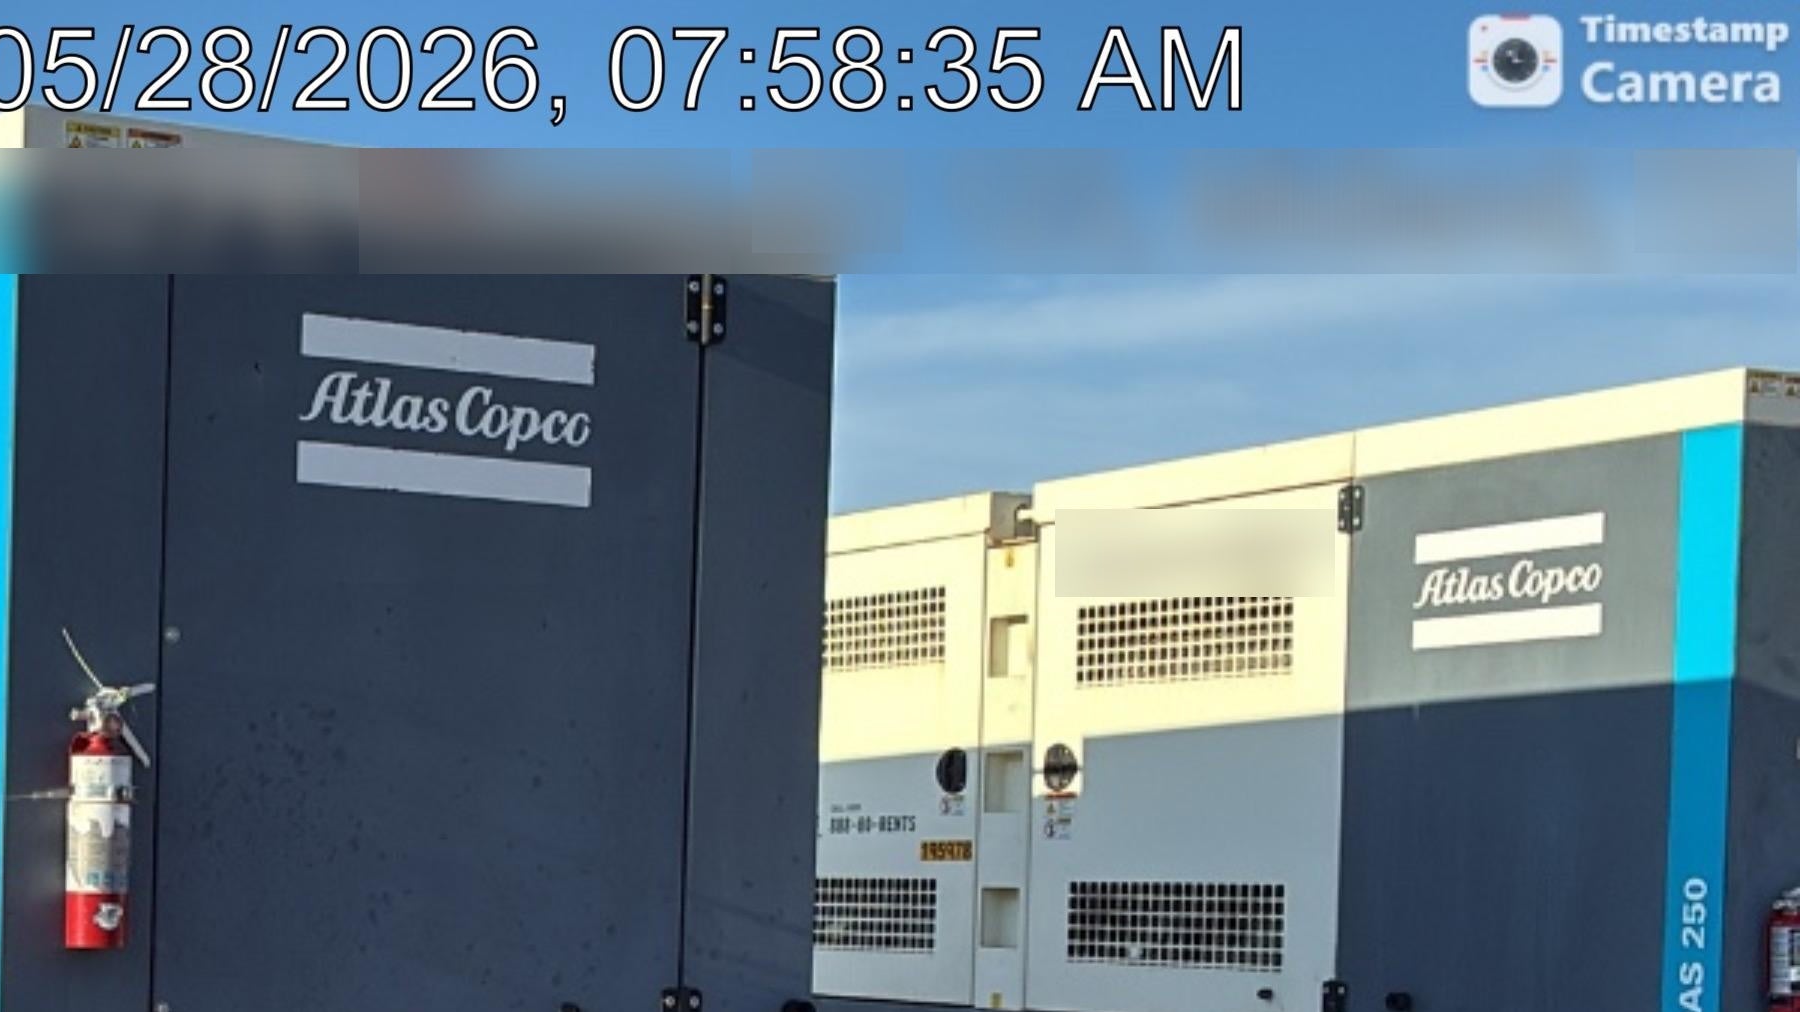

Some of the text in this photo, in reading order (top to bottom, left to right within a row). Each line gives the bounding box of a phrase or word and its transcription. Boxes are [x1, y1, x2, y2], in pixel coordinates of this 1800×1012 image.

[299, 370, 591, 452] Atlas Copco
[1412, 559, 1602, 609] Atlas Copco
[1682, 877, 1708, 949] 250
